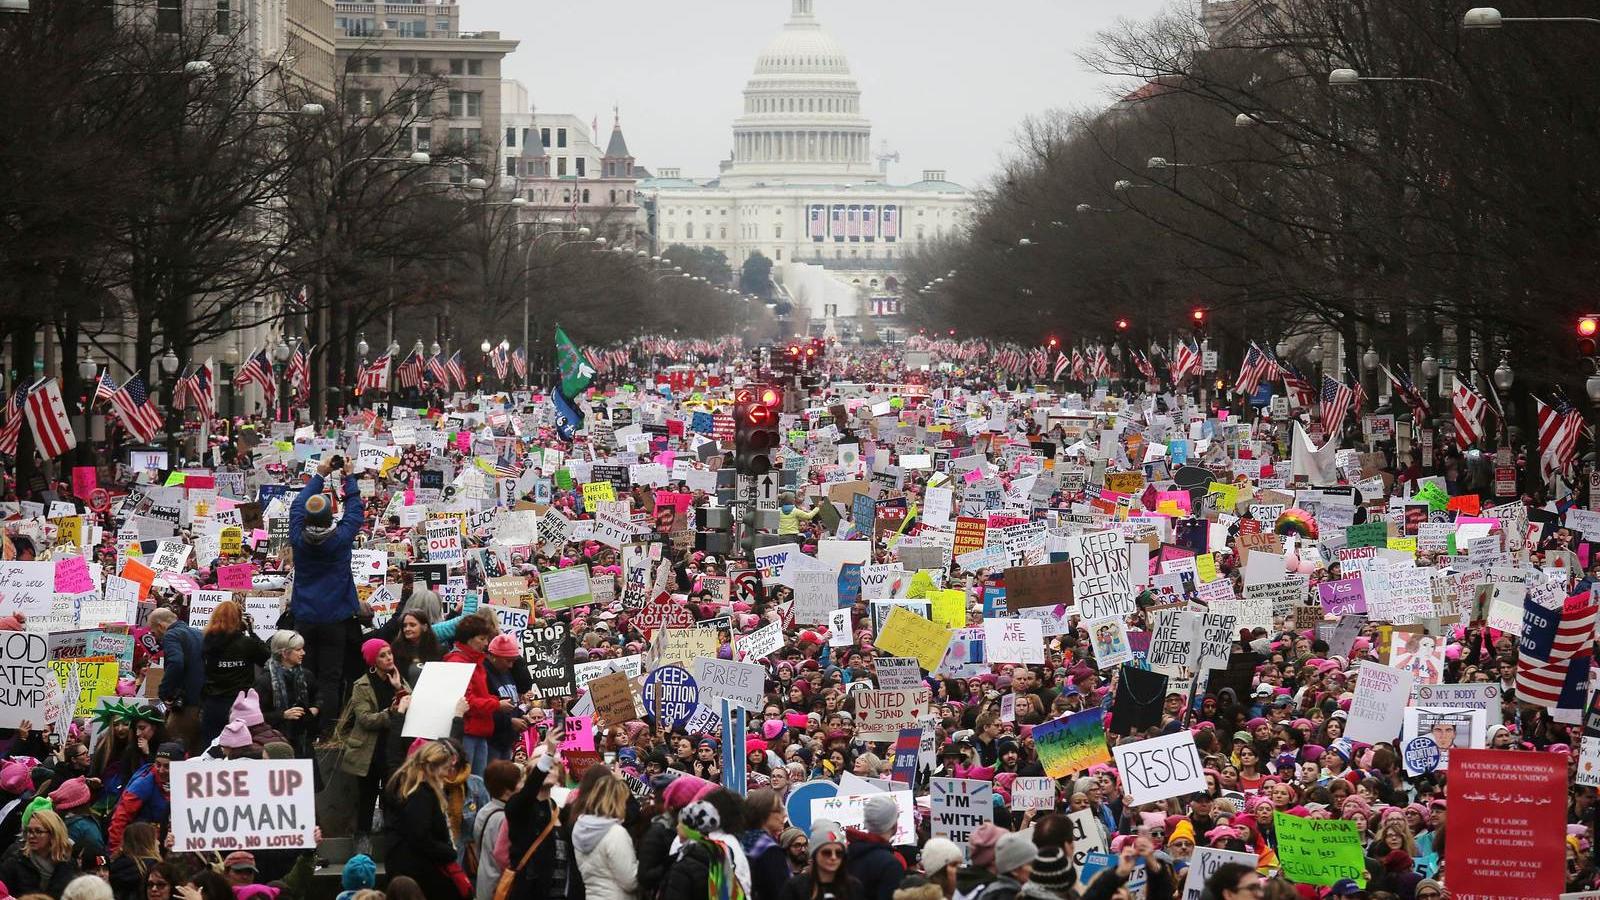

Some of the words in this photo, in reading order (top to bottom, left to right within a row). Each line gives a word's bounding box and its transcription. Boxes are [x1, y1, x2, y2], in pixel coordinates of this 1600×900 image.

[760, 501, 776, 510] THIS
[544, 510, 567, 532] WHERE
[427, 527, 458, 539] PROTECTING
[430, 538, 458, 549] OUR
[1080, 532, 1118, 555] KEEP
[429, 550, 461, 561] DEMOCRACY
[1340, 547, 1376, 561] DIVERSITY
[1072, 548, 1130, 578] RAPISTS
[1079, 577, 1108, 596] OFF
[1111, 573, 1131, 592] MY
[1247, 582, 1266, 592] KEEP
[1328, 582, 1352, 594] Yes
[199, 594, 222, 602] MAKE
[1322, 594, 1362, 604] Women
[648, 604, 678, 614] STOP
[1081, 592, 1135, 619] CAMPUS
[1297, 608, 1322, 616] BASIC
[1331, 604, 1356, 616] CAN
[634, 613, 694, 625] VIOLENCE
[1160, 612, 1181, 628] WE
[1202, 614, 1236, 630] NEVER
[1524, 612, 1548, 628] ITED
[670, 630, 694, 638] WANT
[700, 630, 715, 638] MY
[1006, 623, 1021, 632] WE
[1155, 628, 1177, 640] ARE
[523, 625, 565, 644] STOP
[1003, 632, 1026, 642] ARE
[1153, 641, 1190, 654] CITIZENS
[1201, 642, 1229, 660] BACK
[684, 650, 694, 660] Up
[1150, 652, 1186, 664] UNITED
[0, 665, 45, 688] ATES
[528, 665, 565, 680] Footing
[654, 668, 688, 684] KEEP
[702, 662, 752, 688] FREE
[1362, 666, 1400, 684] WOMEN'S
[530, 682, 572, 700] Around
[1360, 678, 1392, 693] RIGHTS
[0, 689, 46, 708] RUMP
[645, 684, 696, 701] AORTION
[1358, 688, 1375, 699] ARE
[1436, 690, 1450, 700] MY
[1454, 690, 1477, 698] BODY
[858, 692, 905, 710] UNITED
[913, 691, 928, 705] WE
[1354, 698, 1388, 711] HUMAN
[1442, 701, 1486, 710] DECISION
[650, 701, 690, 720] LEGAL
[875, 709, 904, 718] STAND
[1353, 709, 1386, 722] RIGHTS
[696, 708, 709, 728] NOT
[858, 723, 883, 731] POWER
[887, 724, 894, 732] TO
[1410, 738, 1432, 750] KEEP
[1124, 742, 1198, 794] RESIST
[1461, 762, 1498, 770] HACEMOS
[1482, 772, 1518, 780] ESTADOS
[1519, 774, 1549, 782] UNIDOS
[186, 770, 250, 798] RISE
[268, 770, 302, 796] UP
[1016, 779, 1036, 792] NOT
[1039, 778, 1055, 790] MY
[946, 794, 970, 808] I'M
[1012, 795, 1054, 808] PRESIDENT
[187, 804, 306, 834] WOMAN.
[940, 812, 983, 826] WITH
[1501, 818, 1528, 826] LABOR
[1308, 822, 1351, 832] VAGINA
[1495, 828, 1534, 836] SACRIFICE
[186, 838, 206, 850] NO
[212, 837, 242, 850] MUD,
[246, 836, 260, 847] NO
[266, 834, 304, 846] LOTUS
[950, 831, 970, 842] HE
[1322, 836, 1359, 844] BULLETS
[1494, 838, 1534, 847] CHILDREN
[1467, 858, 1480, 866] WE
[1481, 858, 1518, 868] ALREADY
[1519, 860, 1542, 868] MAKE
[1281, 860, 1360, 880] REGULATED
[1473, 870, 1508, 878] AMERICA
